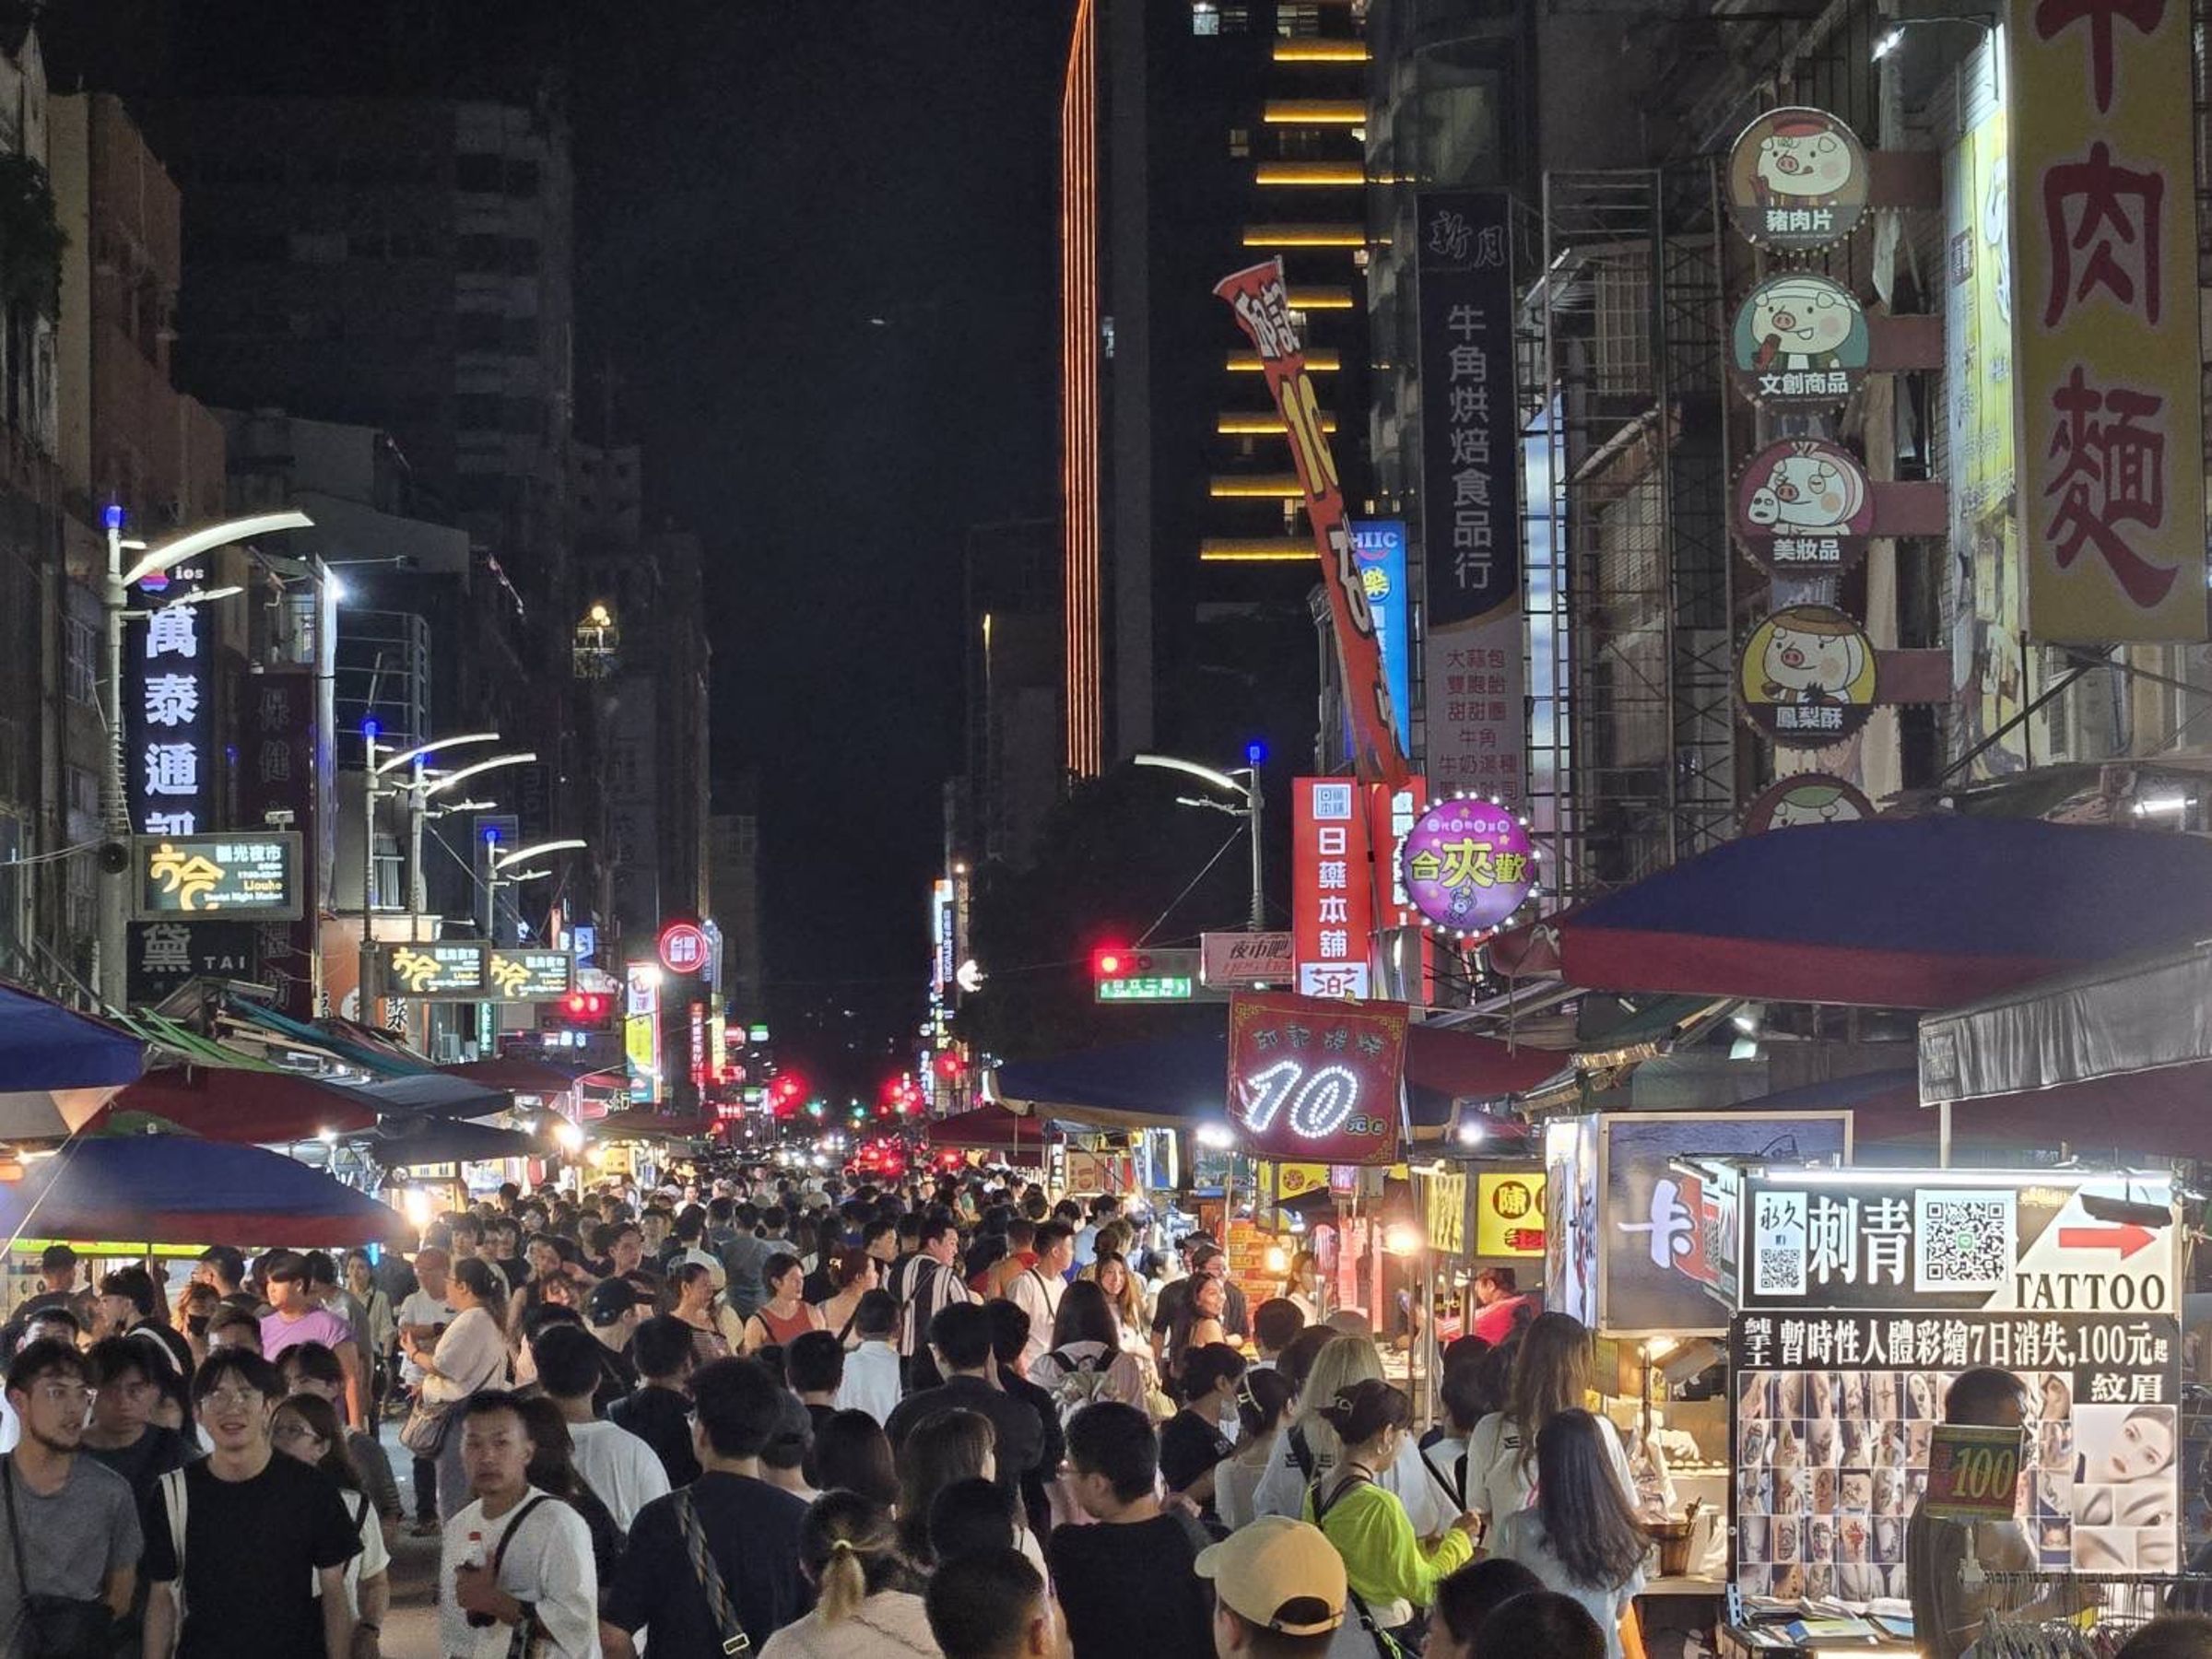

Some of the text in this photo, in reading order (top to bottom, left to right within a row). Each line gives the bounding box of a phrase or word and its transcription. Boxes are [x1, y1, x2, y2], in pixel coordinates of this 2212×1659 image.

[1766, 209, 1833, 231] 豬肉片
[1759, 372, 1849, 394] 文創商品
[1448, 305, 1491, 591] 牛角烘焙食品行
[1773, 539, 1840, 561] 美妝品
[1776, 707, 1842, 729] 鳳梨酥
[1319, 828, 1347, 959] 日藥本舖
[203, 956, 246, 970] TAI
[1246, 1061, 1358, 1138] 10
[1808, 1196, 1912, 1285] 刺青
[2015, 1273, 2165, 1311] TATTOO
[2090, 1372, 2163, 1403] 紋眉
[1951, 1447, 2016, 1500] 100
